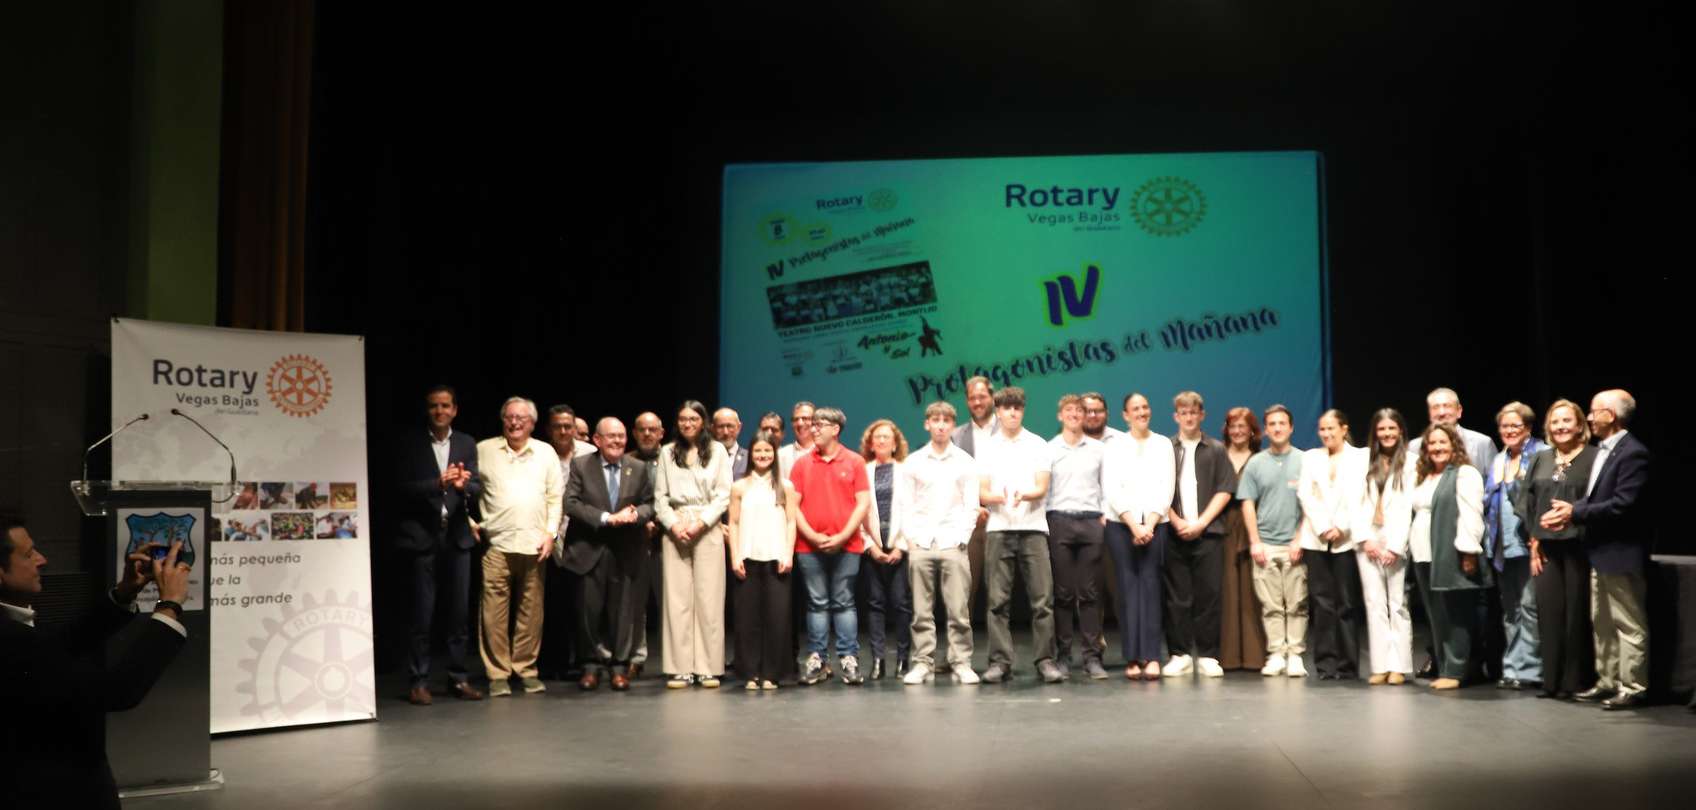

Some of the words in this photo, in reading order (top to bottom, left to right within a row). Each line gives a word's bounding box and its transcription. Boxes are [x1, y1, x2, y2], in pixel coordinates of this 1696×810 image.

[816, 195, 863, 211] Rotary
[1005, 183, 1121, 211] Rotary
[1028, 212, 1075, 226] Vegas
[1078, 211, 1121, 225] Bajas
[767, 260, 784, 280] IV
[1044, 265, 1099, 326] IV
[1161, 307, 1279, 352] Mañana
[152, 359, 258, 394] Rotary
[176, 392, 218, 407] Vegas
[222, 395, 259, 409] Bajas
[239, 552, 301, 568] pequeña
[211, 577, 224, 585] ue
[228, 574, 241, 585] la
[240, 592, 293, 608] grande
[293, 607, 369, 633] ROTARY
